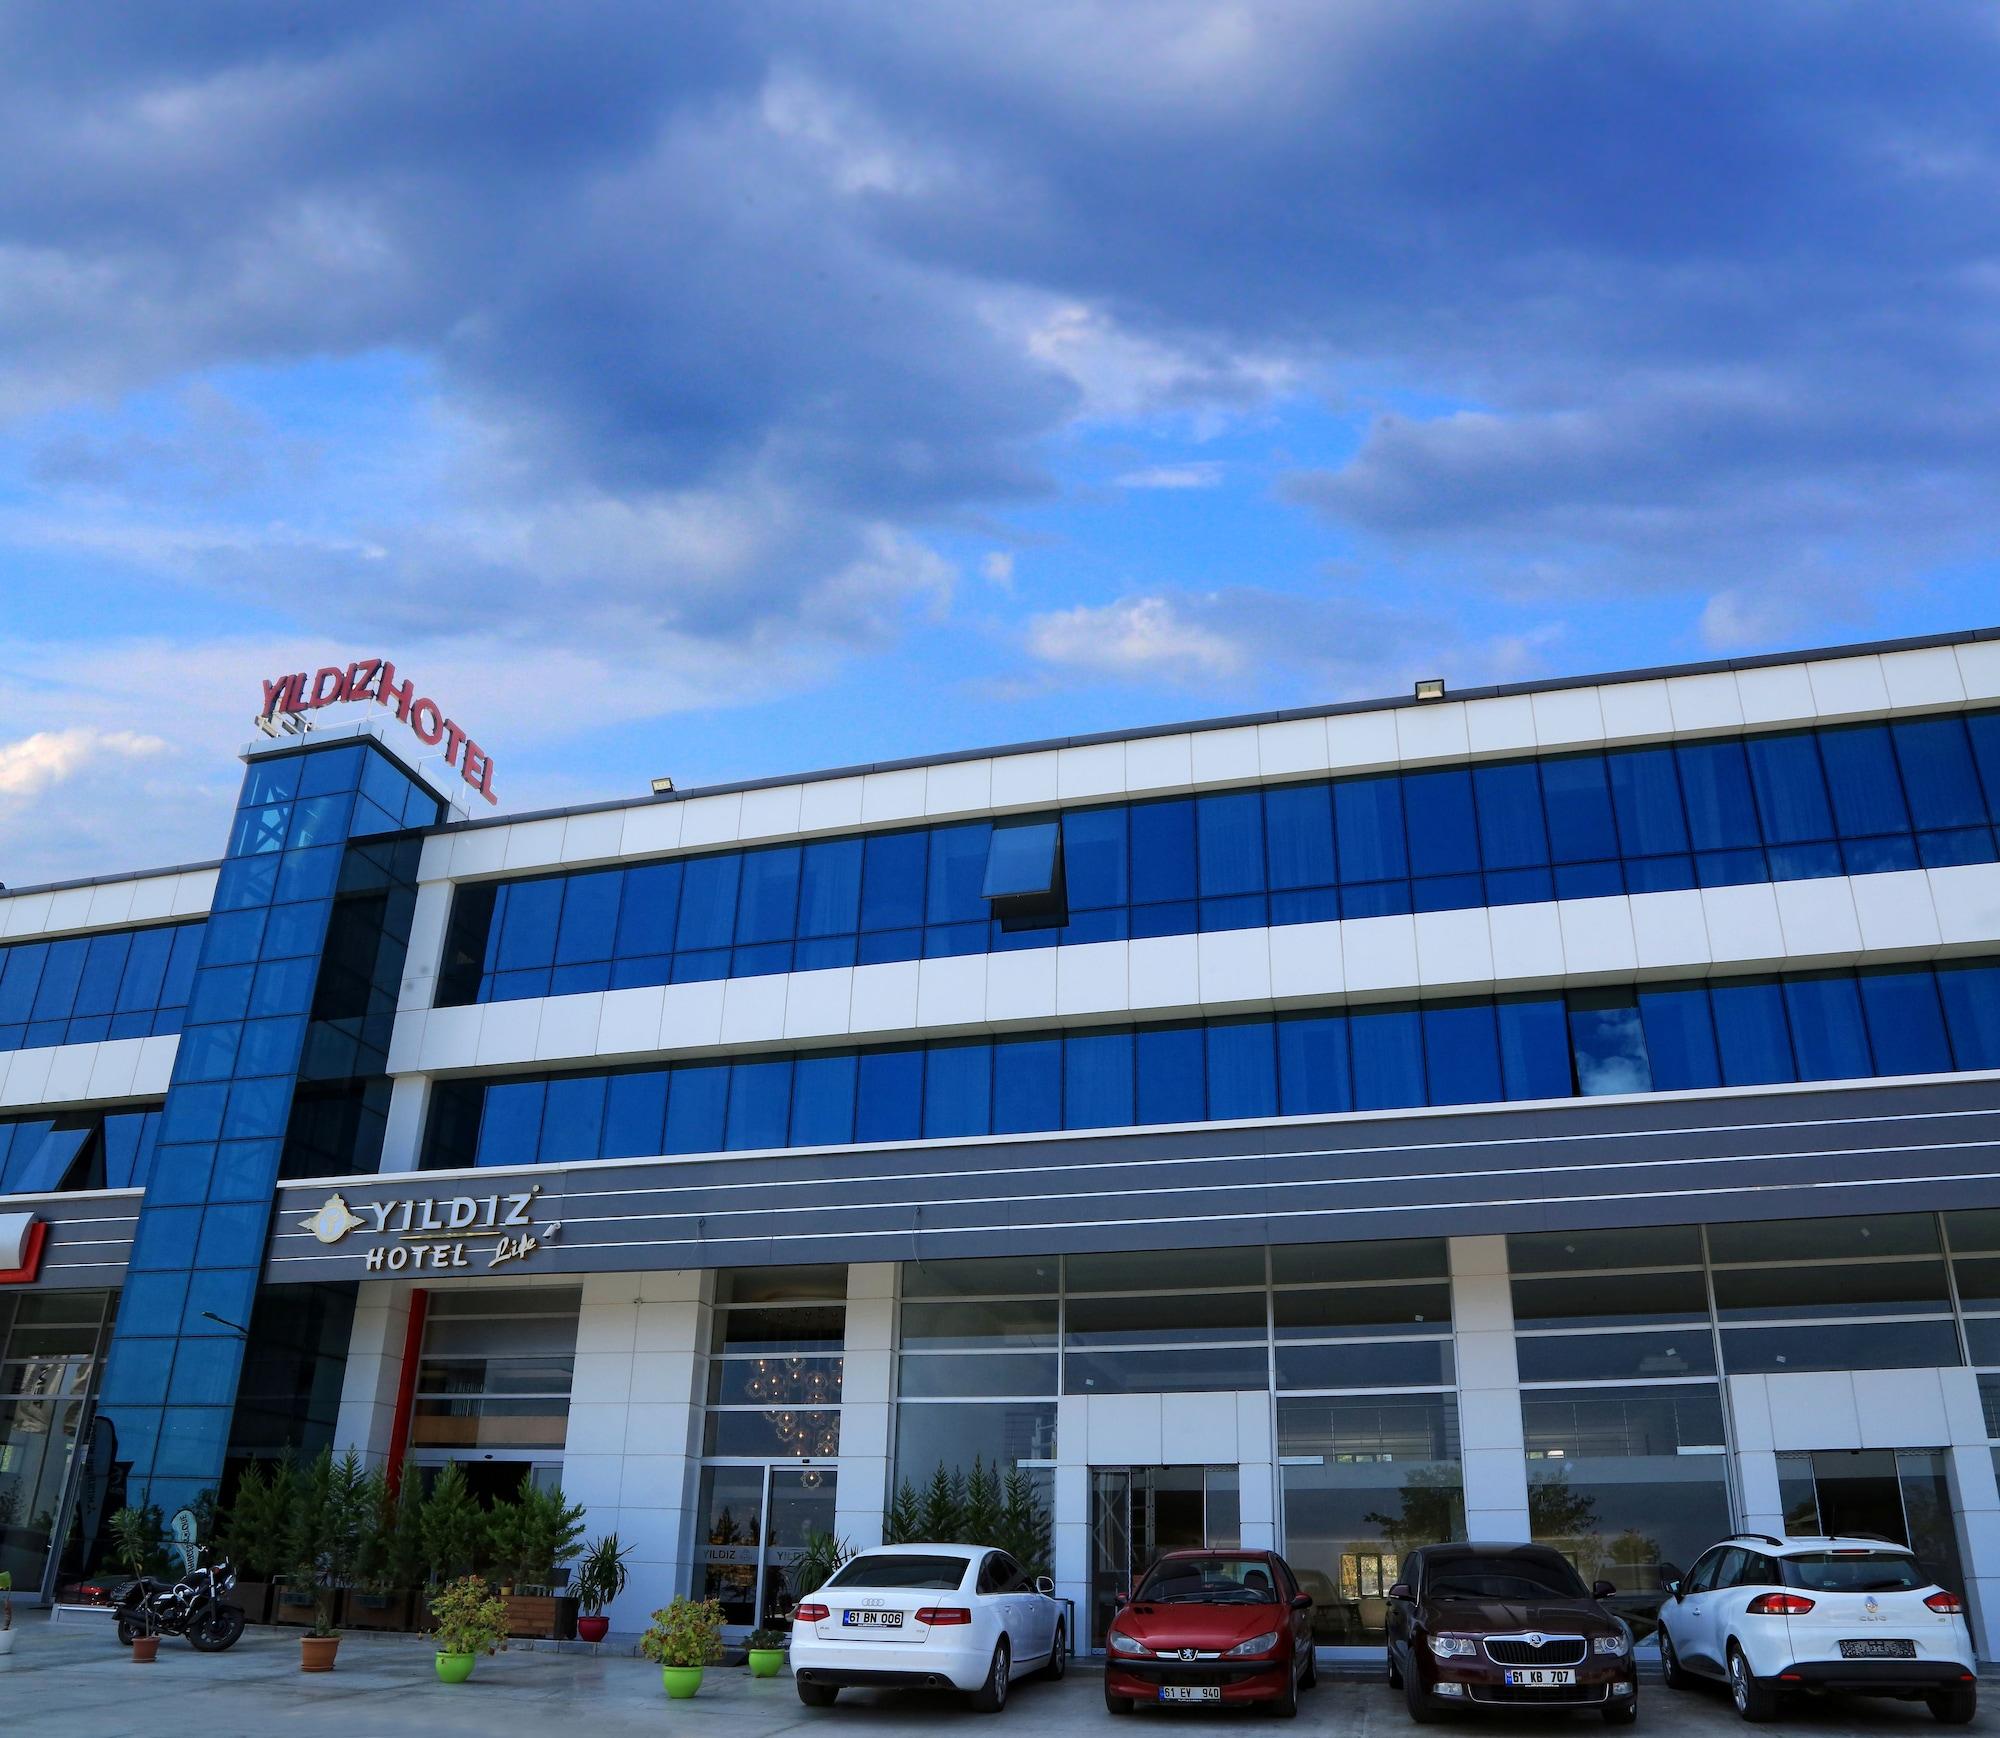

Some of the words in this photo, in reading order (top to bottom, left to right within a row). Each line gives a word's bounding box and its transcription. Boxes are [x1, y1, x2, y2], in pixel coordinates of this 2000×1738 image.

[262, 658, 382, 718] YILDIZ
[376, 661, 498, 806] HOTEL
[372, 1193, 532, 1232] YILDIZ
[365, 1243, 469, 1272] HOTEL
[487, 1232, 537, 1269] Life
[704, 1550, 736, 1560] YILDIZ
[849, 1612, 860, 1623] 61
[864, 1613, 877, 1623] BN
[881, 1613, 901, 1624] 006
[1512, 1671, 1523, 1683] 61
[1530, 1671, 1543, 1683] KB
[1551, 1671, 1569, 1683] 707
[1165, 1688, 1175, 1697] 61
[1180, 1688, 1191, 1697] EV
[1202, 1688, 1219, 1697] 940
